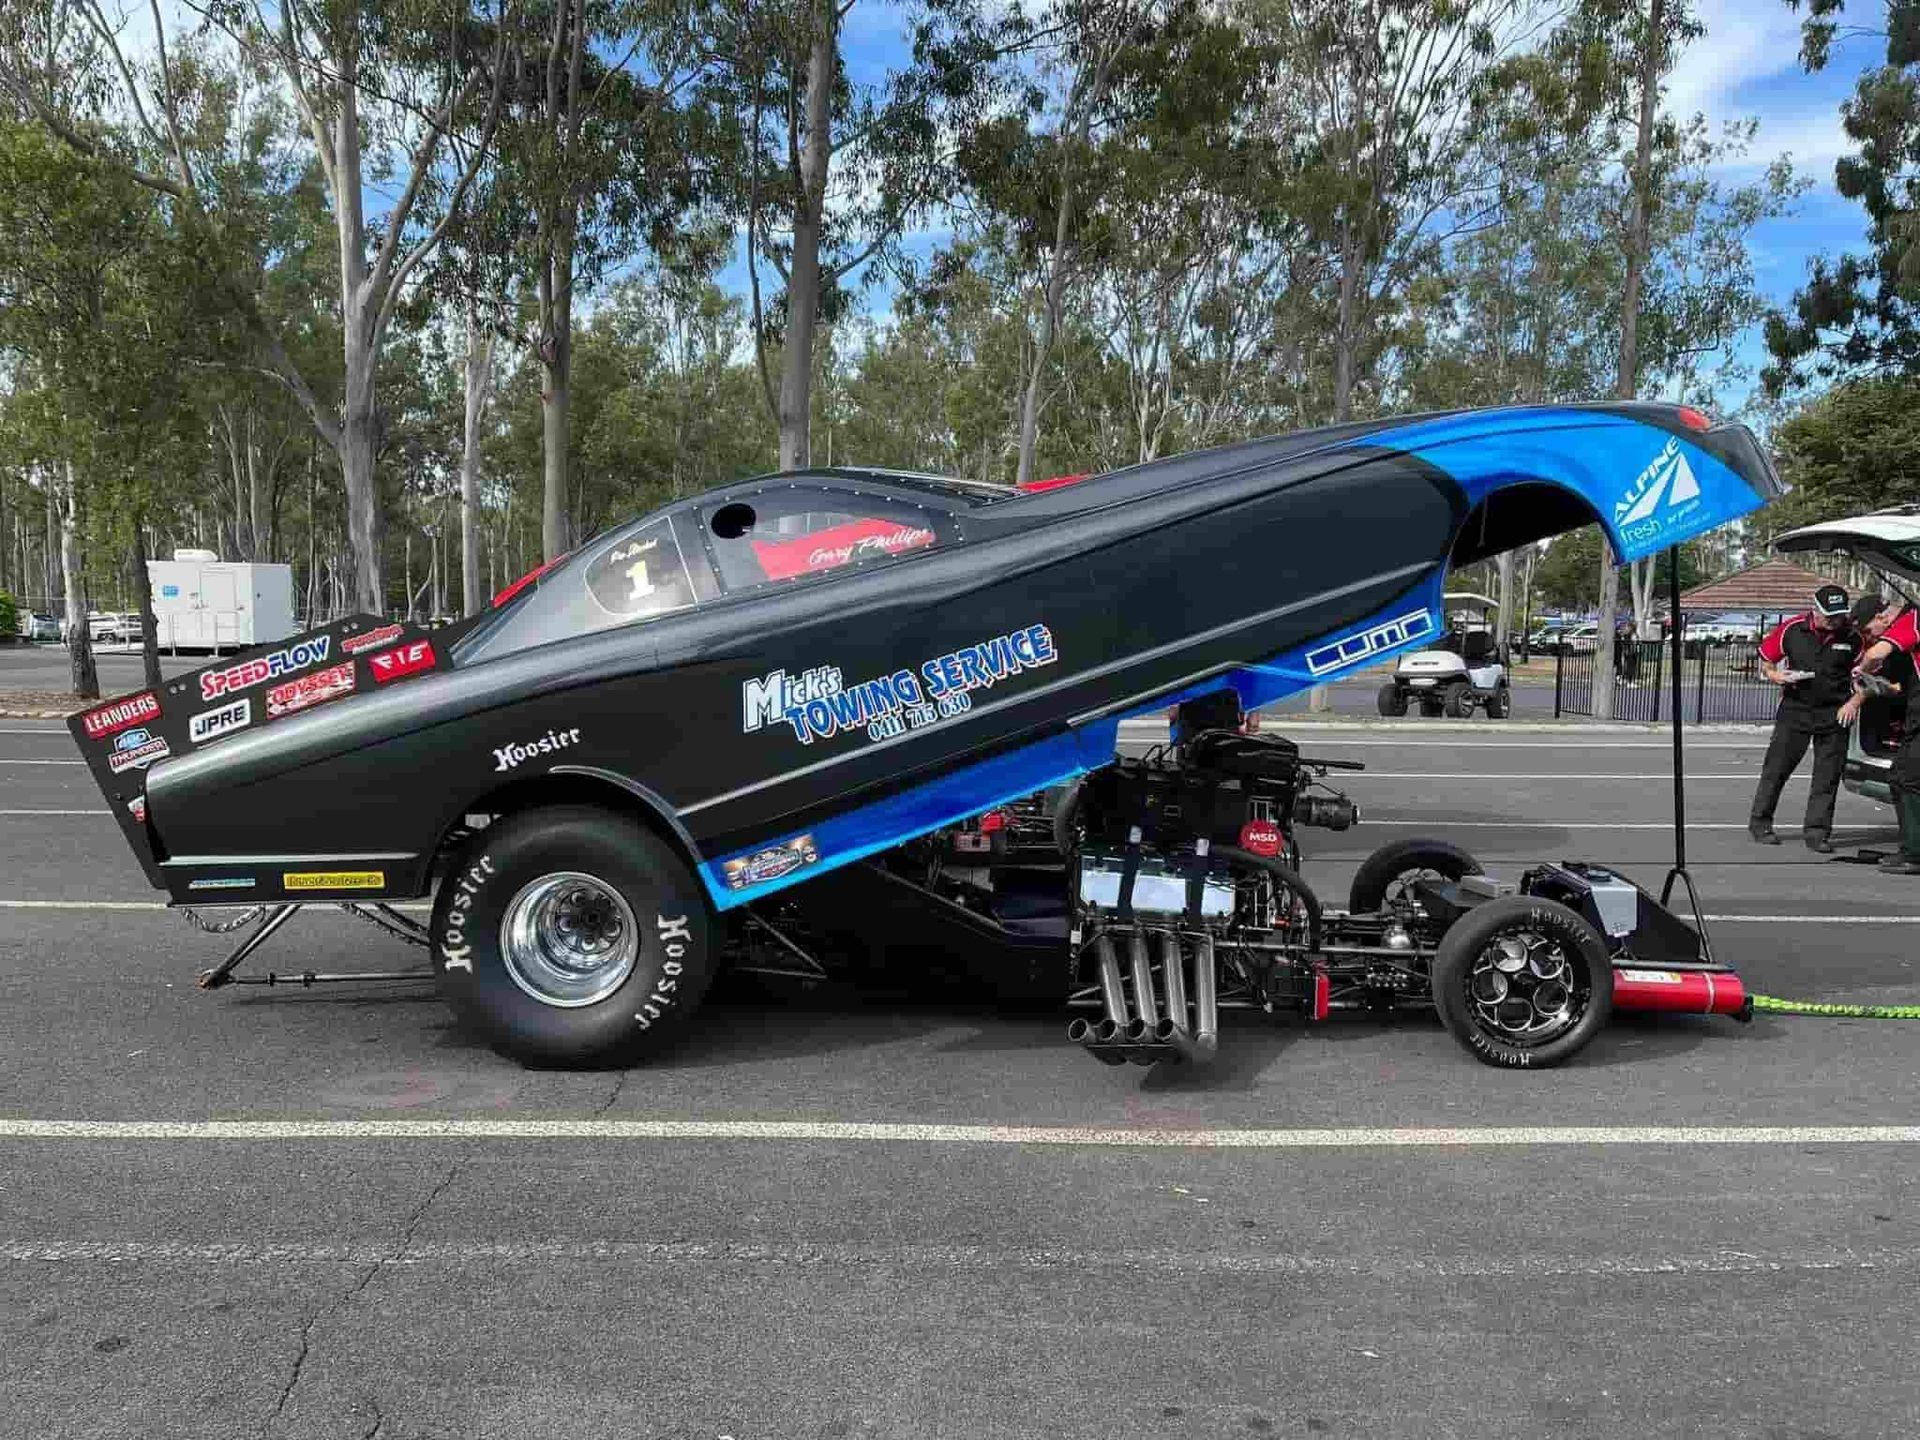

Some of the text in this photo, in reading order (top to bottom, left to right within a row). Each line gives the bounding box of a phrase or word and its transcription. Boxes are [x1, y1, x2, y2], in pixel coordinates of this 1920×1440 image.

[1614, 434, 1680, 523] ALPINE
[625, 559, 656, 601] 1
[200, 635, 330, 701] SPEEDFLOW
[783, 624, 1058, 744] TOWING SERVICE
[85, 694, 160, 732] LEANDERS
[195, 705, 246, 736] JPRE
[492, 728, 580, 772] Hoosier
[1249, 832, 1277, 842] MSD
[442, 854, 495, 974] Hoosier
[635, 913, 692, 1030] Hoosier
